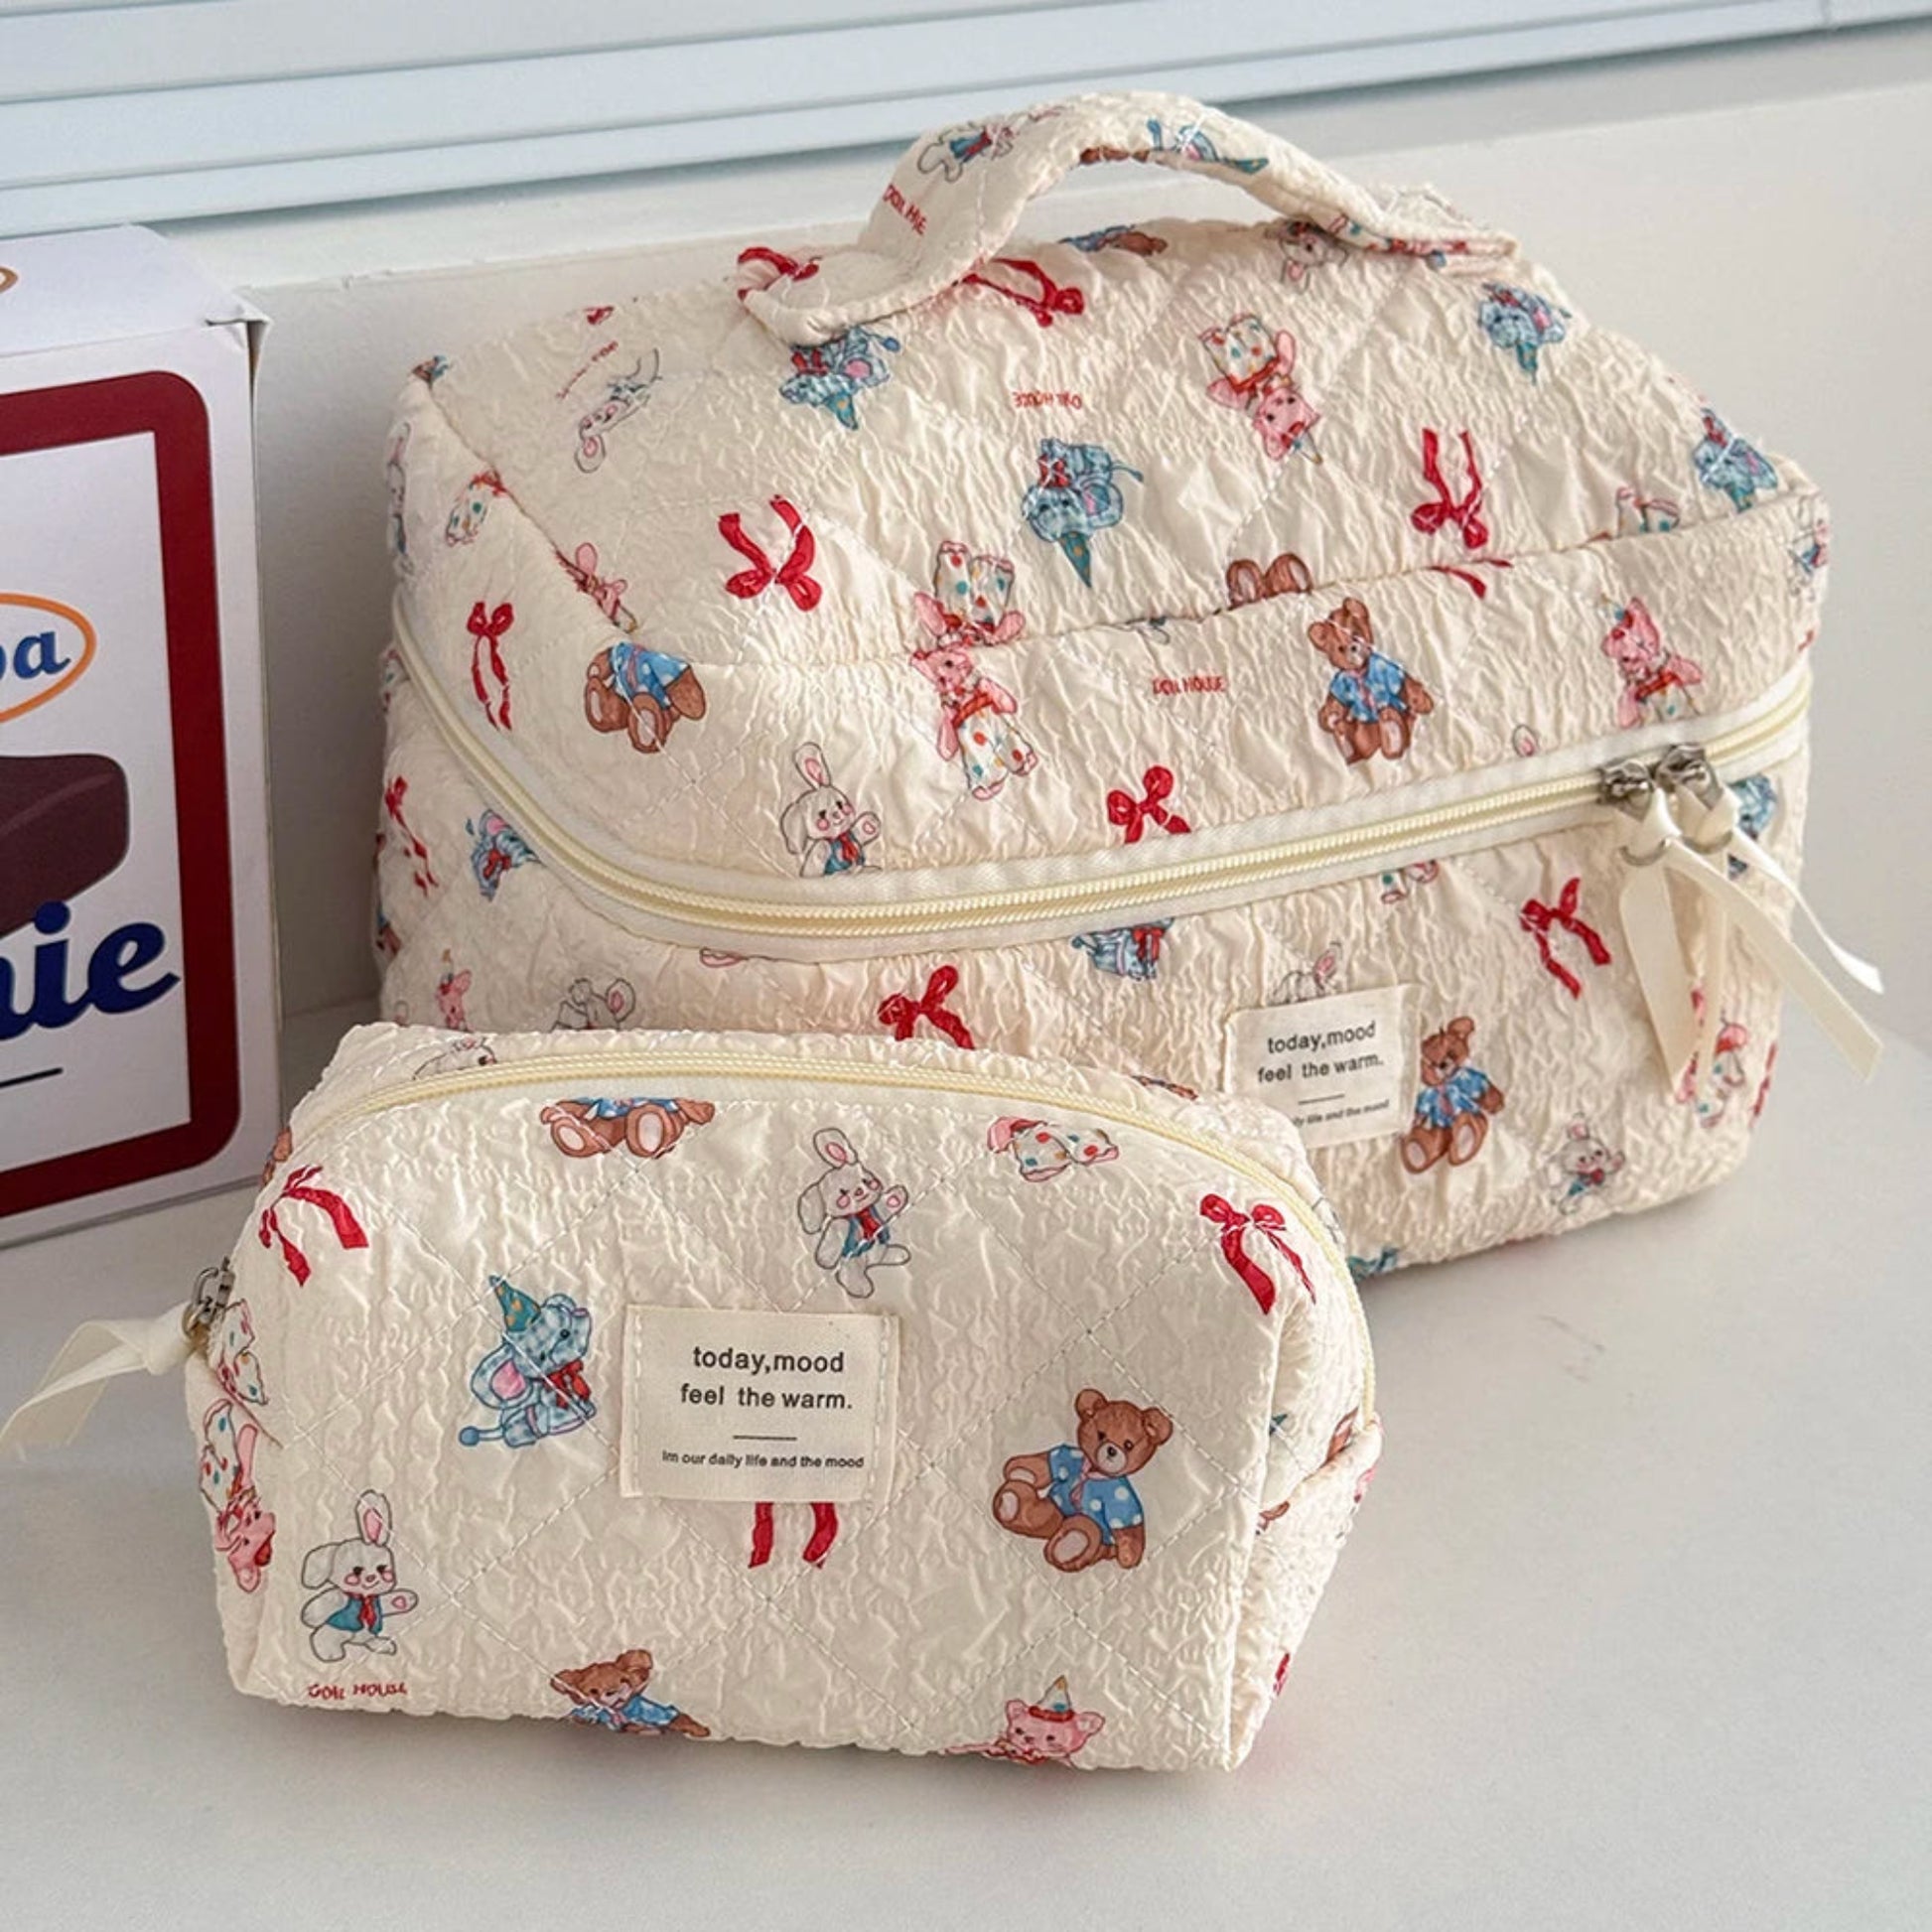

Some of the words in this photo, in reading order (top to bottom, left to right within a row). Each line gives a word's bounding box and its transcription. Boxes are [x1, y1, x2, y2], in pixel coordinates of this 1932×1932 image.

[0, 629, 71, 680] a
[1258, 1064, 1292, 1083] feel
[1302, 1061, 1329, 1078] the
[1334, 1053, 1384, 1073] warm.
[680, 1383, 725, 1406] feel
[738, 1387, 775, 1408] the
[781, 1393, 853, 1410] warm.
[682, 1452, 706, 1464] our
[709, 1452, 743, 1469] daily
[746, 1453, 767, 1467] life
[770, 1455, 797, 1468] and
[800, 1455, 822, 1467] the
[825, 1456, 865, 1468] mood
